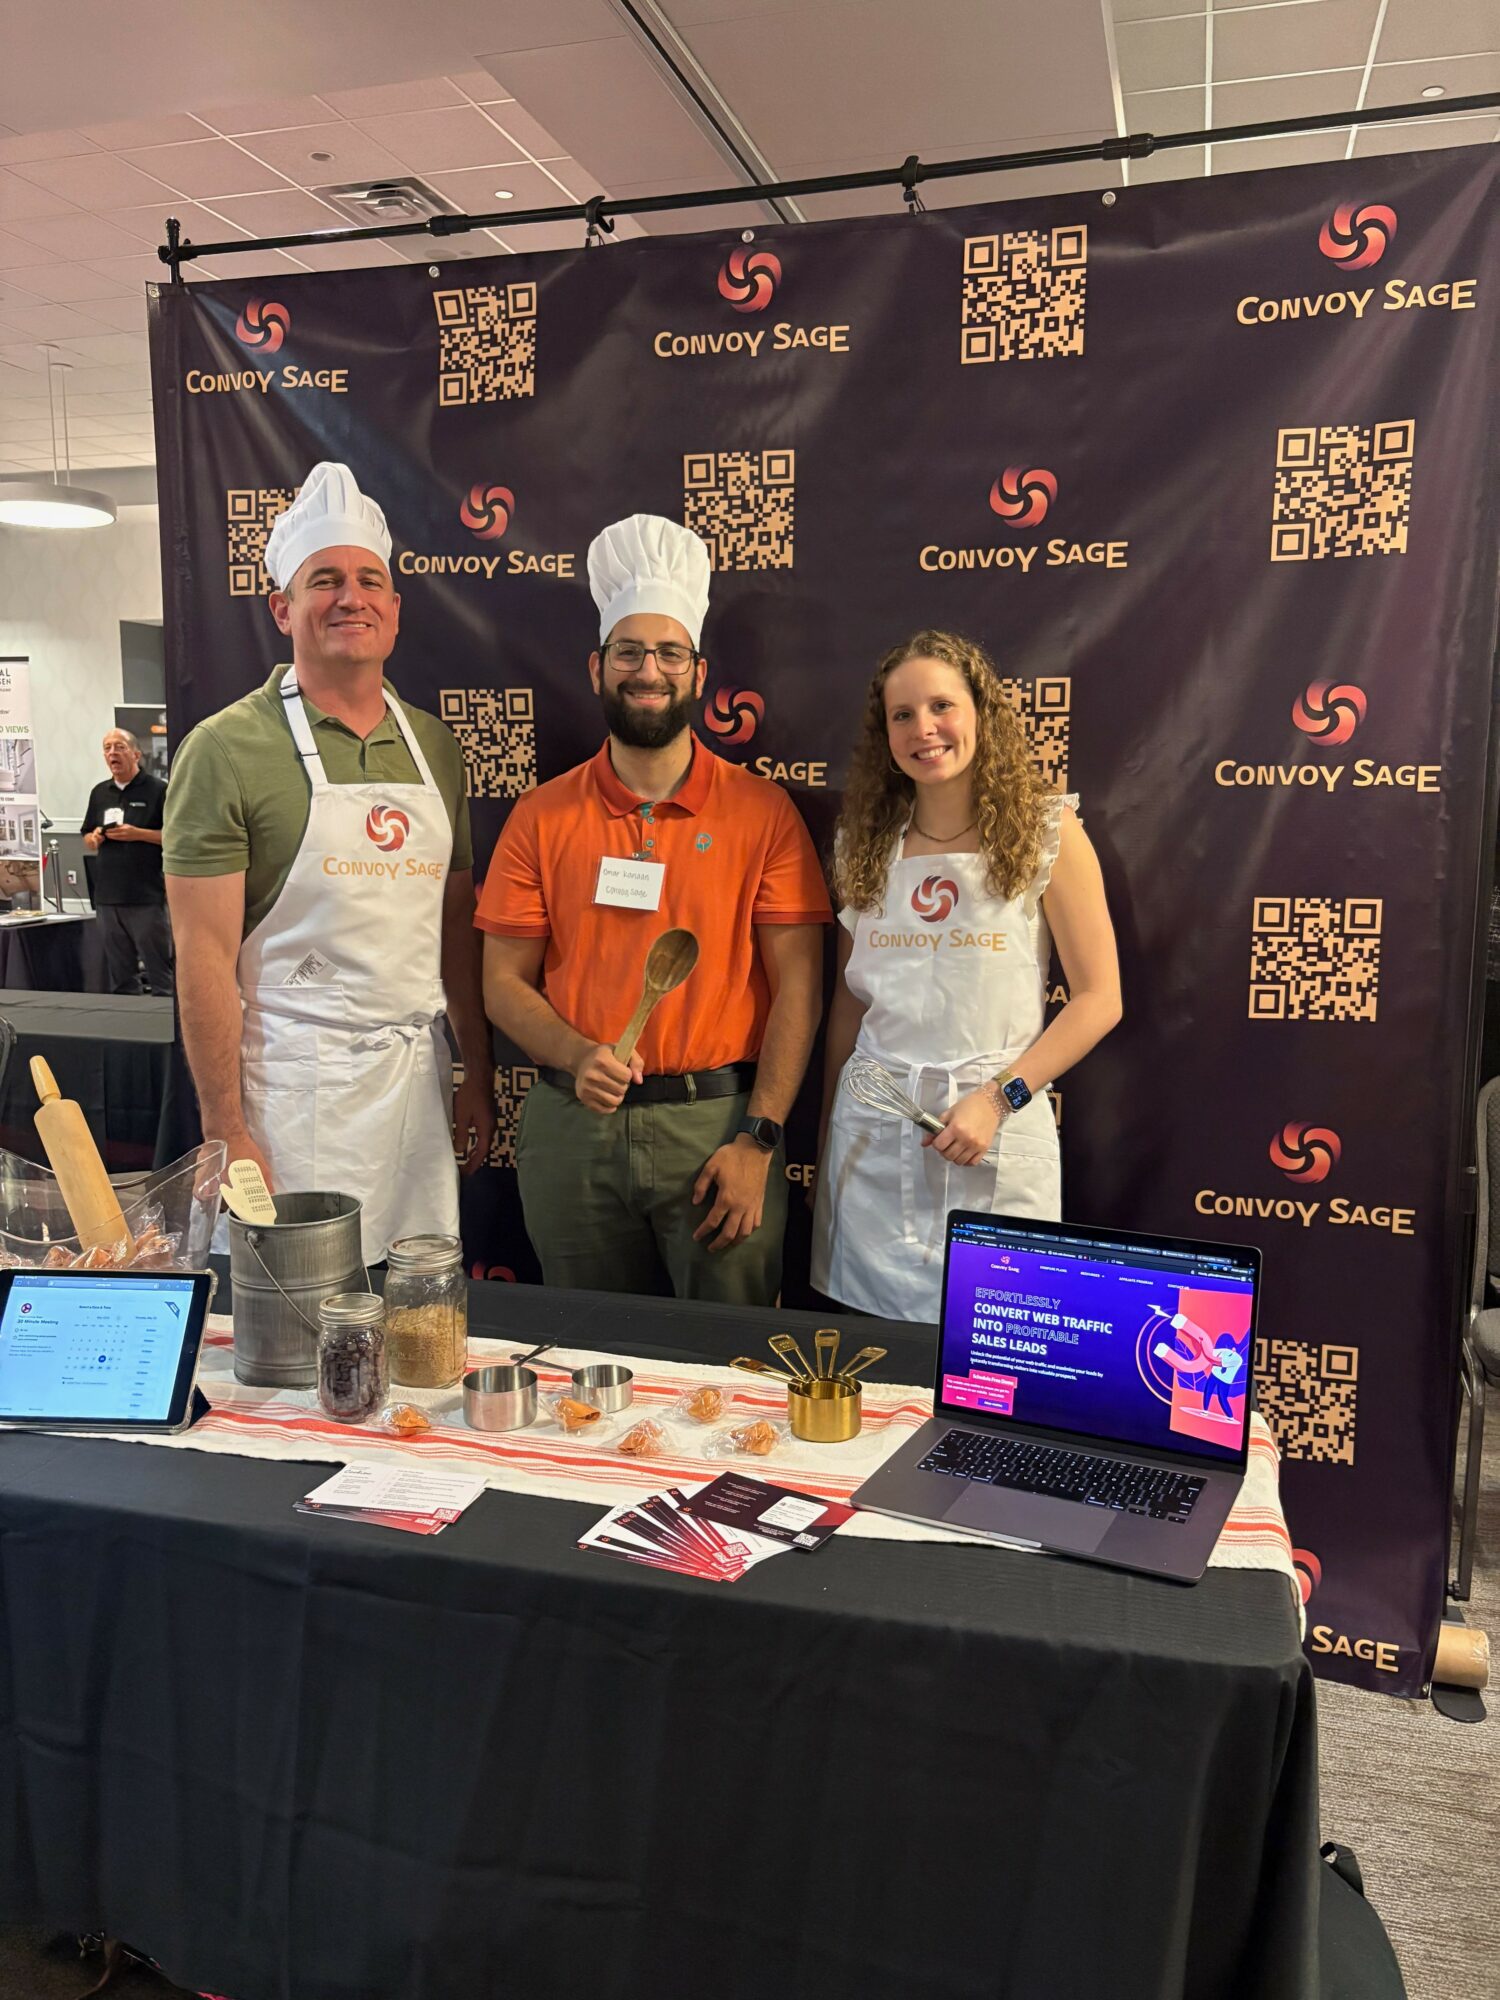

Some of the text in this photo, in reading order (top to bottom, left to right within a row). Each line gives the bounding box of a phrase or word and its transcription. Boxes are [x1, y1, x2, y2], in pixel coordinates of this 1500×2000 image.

[1237, 279, 1478, 324] CONVOY SAGE
[654, 323, 850, 357] CONVOY SAGE
[186, 366, 349, 393] CONVOY SAGE
[398, 551, 575, 579] CONVOY SAGE
[920, 539, 1129, 572] CONVOY SAGE
[6, 725, 30, 734] VIEWS
[755, 756, 828, 787] SAGE
[1215, 759, 1442, 793] CONVOY SAGE
[322, 856, 445, 881] CONVOY SAGE
[869, 928, 1008, 952] CONVOY SAGE
[1194, 1189, 1416, 1235] CONVOY SAGE
[975, 1286, 1061, 1310] EFFORTLESSLY
[973, 1317, 1080, 1345] INTO PROFITABLE
[974, 1302, 1113, 1334] CONVERT WEB TRAFFIC
[972, 1333, 1048, 1355] SALES LEADS
[1311, 1626, 1400, 1673] SAGE
